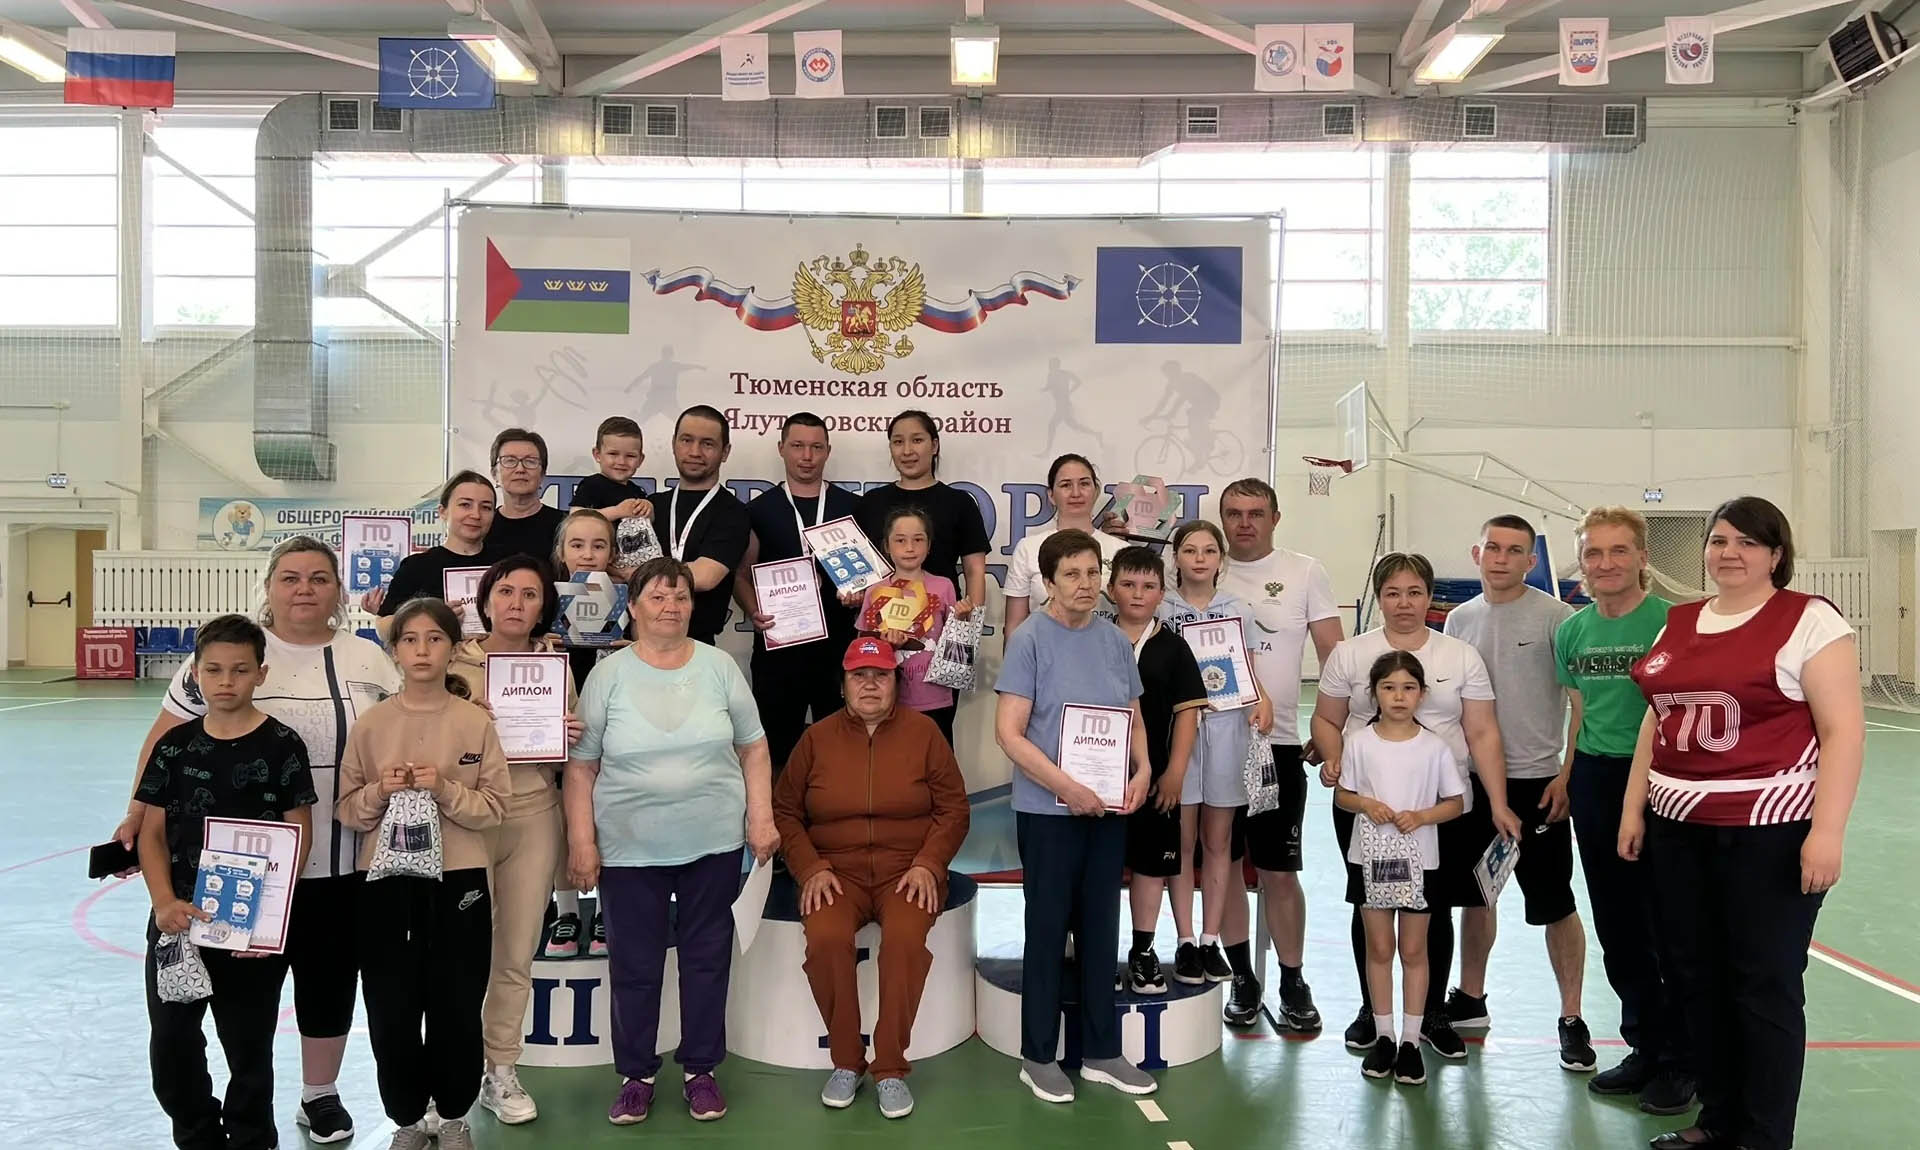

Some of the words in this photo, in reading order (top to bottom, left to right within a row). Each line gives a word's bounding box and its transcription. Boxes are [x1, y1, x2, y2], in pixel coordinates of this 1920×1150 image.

[729, 372, 888, 397] Тюменская
[896, 374, 1004, 399] область
[724, 407, 891, 435] Ялутовски
[362, 523, 391, 542] ГТО
[820, 527, 847, 545] ГТО
[771, 566, 799, 586] ГТО
[769, 584, 807, 598] ДИПЛОМ
[576, 602, 599, 616] ГТО
[889, 603, 910, 617] ГТО
[1199, 628, 1226, 647] ГТО
[85, 643, 123, 668] ГТО
[510, 662, 545, 684] ГТО
[501, 686, 552, 697] ДИПЛОМ
[1081, 713, 1111, 735] ГТО
[1073, 735, 1117, 748] ДИПЛОМ
[464, 752, 482, 761] NIKE
[233, 830, 272, 855] ГТО
